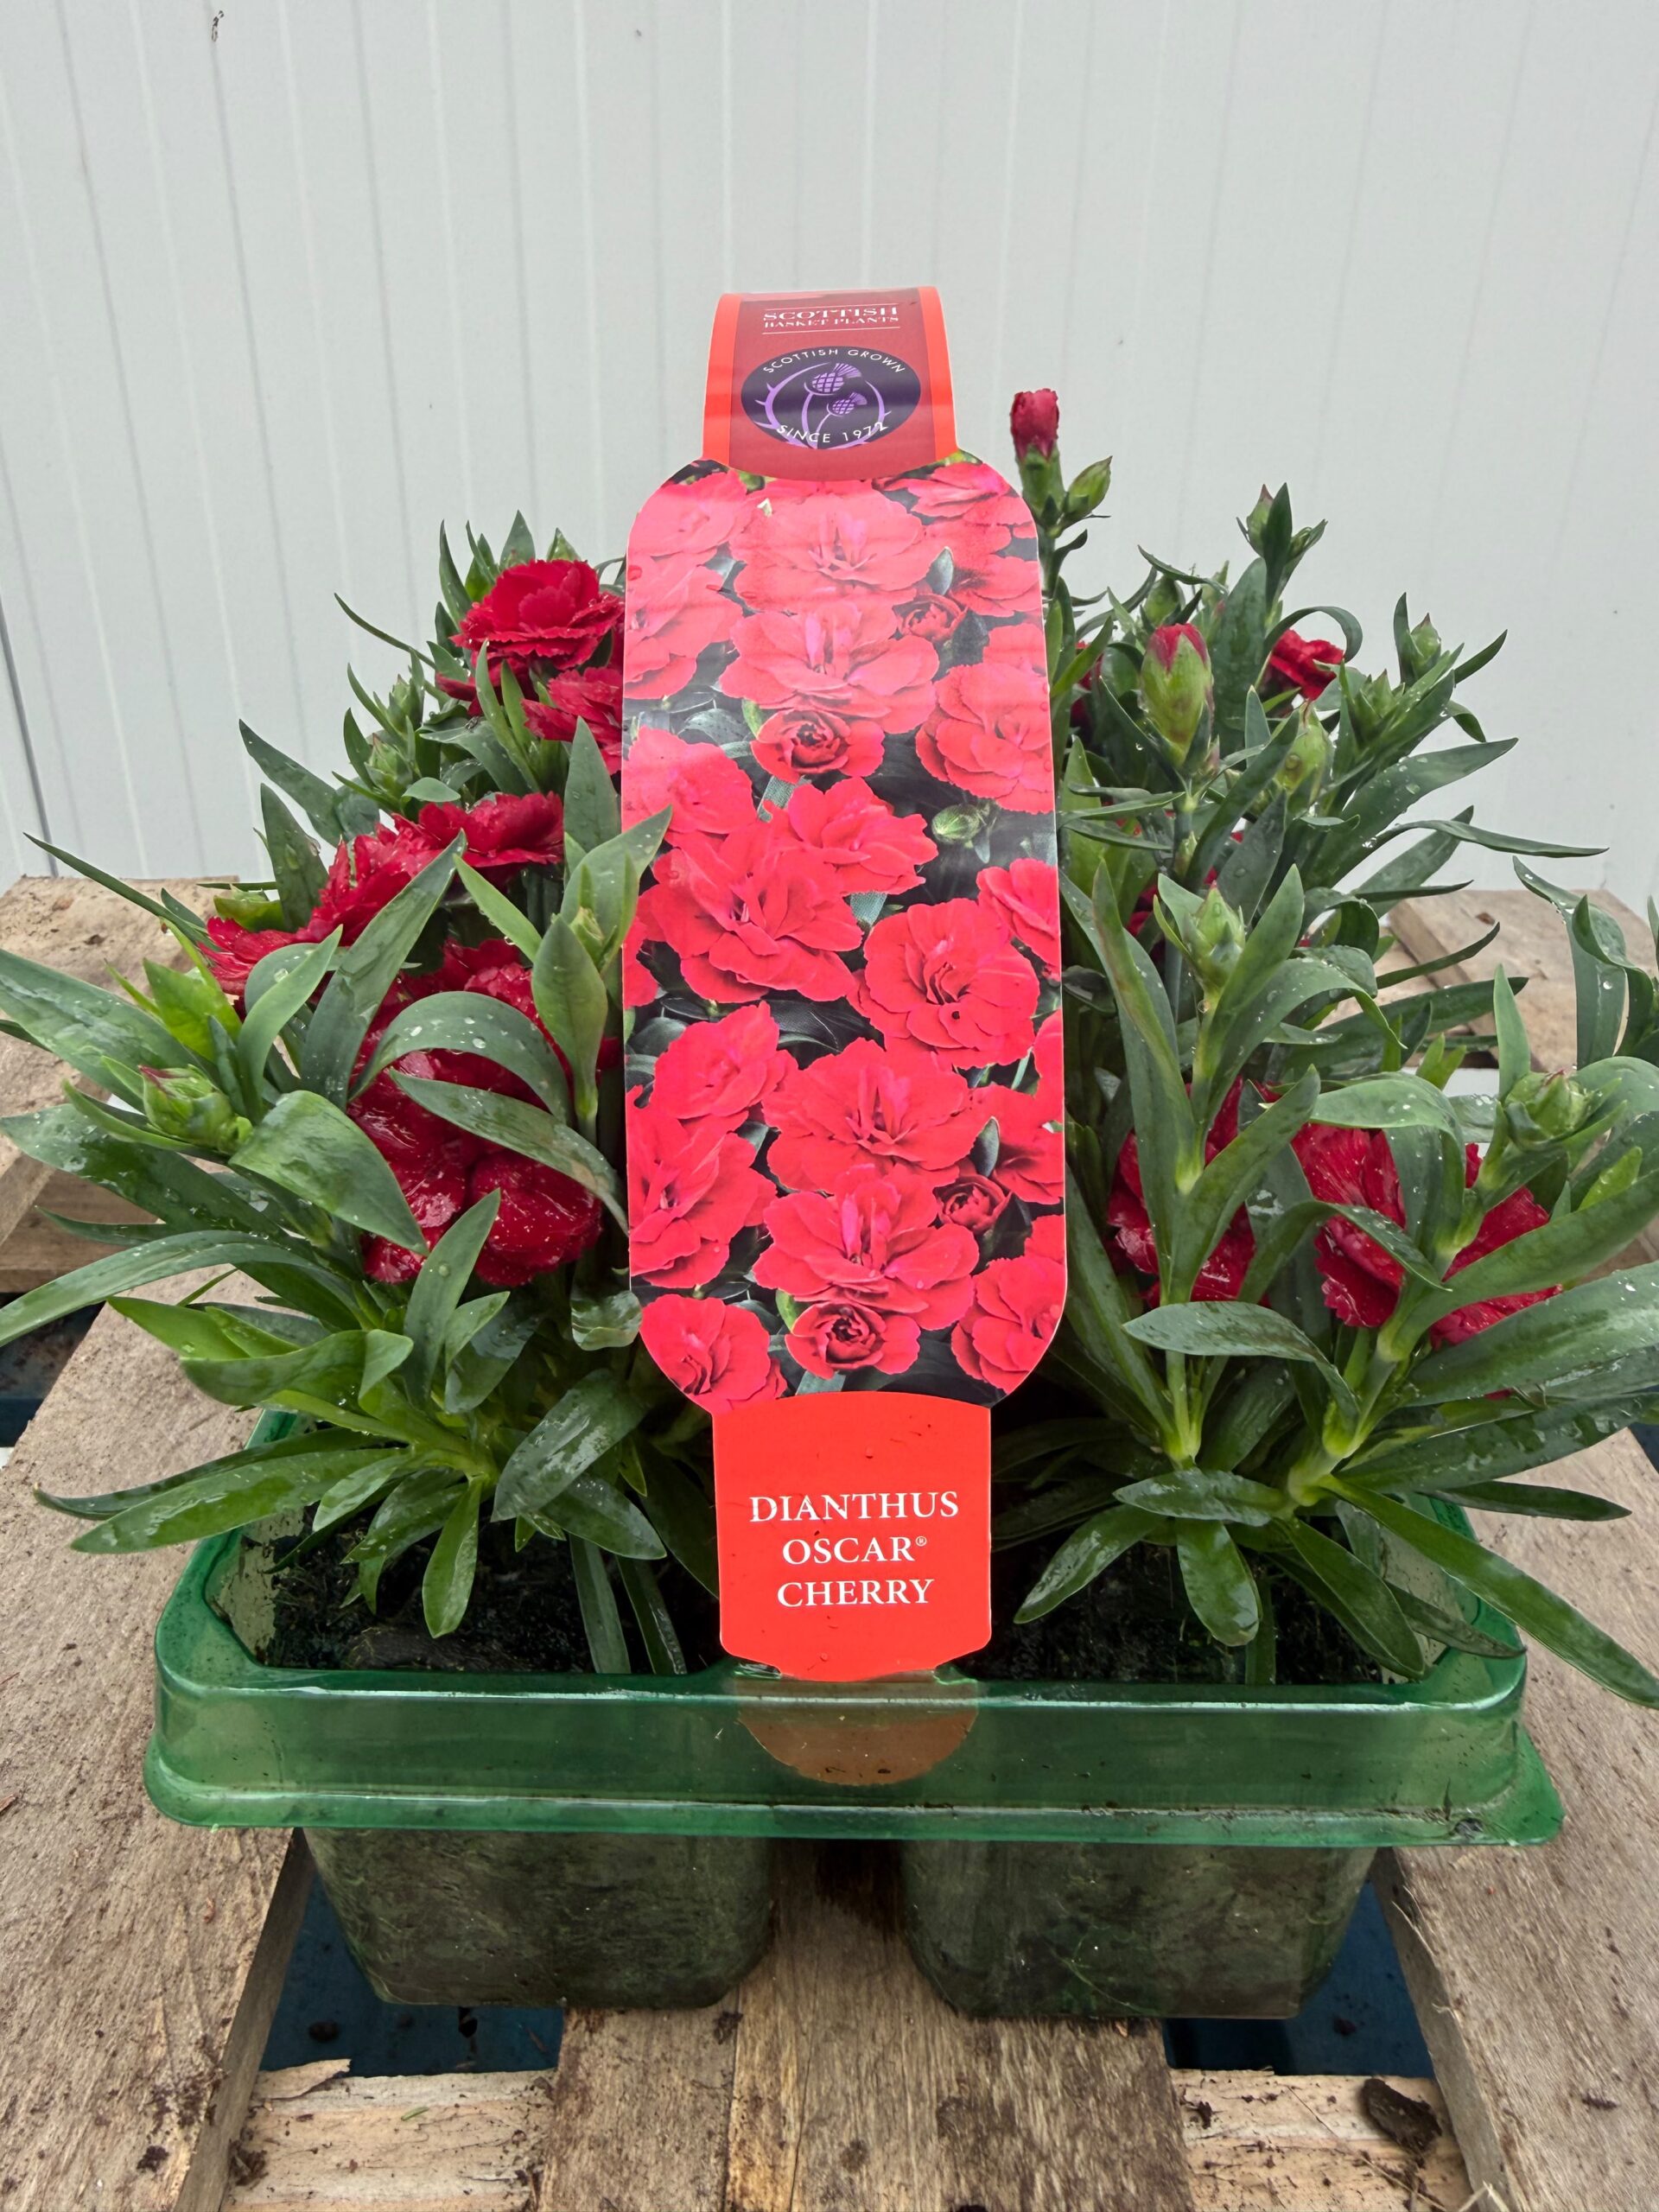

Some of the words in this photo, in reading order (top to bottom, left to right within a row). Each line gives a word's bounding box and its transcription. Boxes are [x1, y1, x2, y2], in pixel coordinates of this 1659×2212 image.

[763, 307, 897, 321] SCOTTISH
[765, 318, 830, 328] BASKET
[834, 316, 899, 326] PLANTS
[763, 348, 838, 373] SCOTTISH
[848, 349, 906, 373] GROWN
[776, 424, 830, 443] SINCE
[843, 422, 890, 442] 1972
[750, 1491, 959, 1522] DIANTHUS
[777, 1579, 935, 1608] CHERRY
